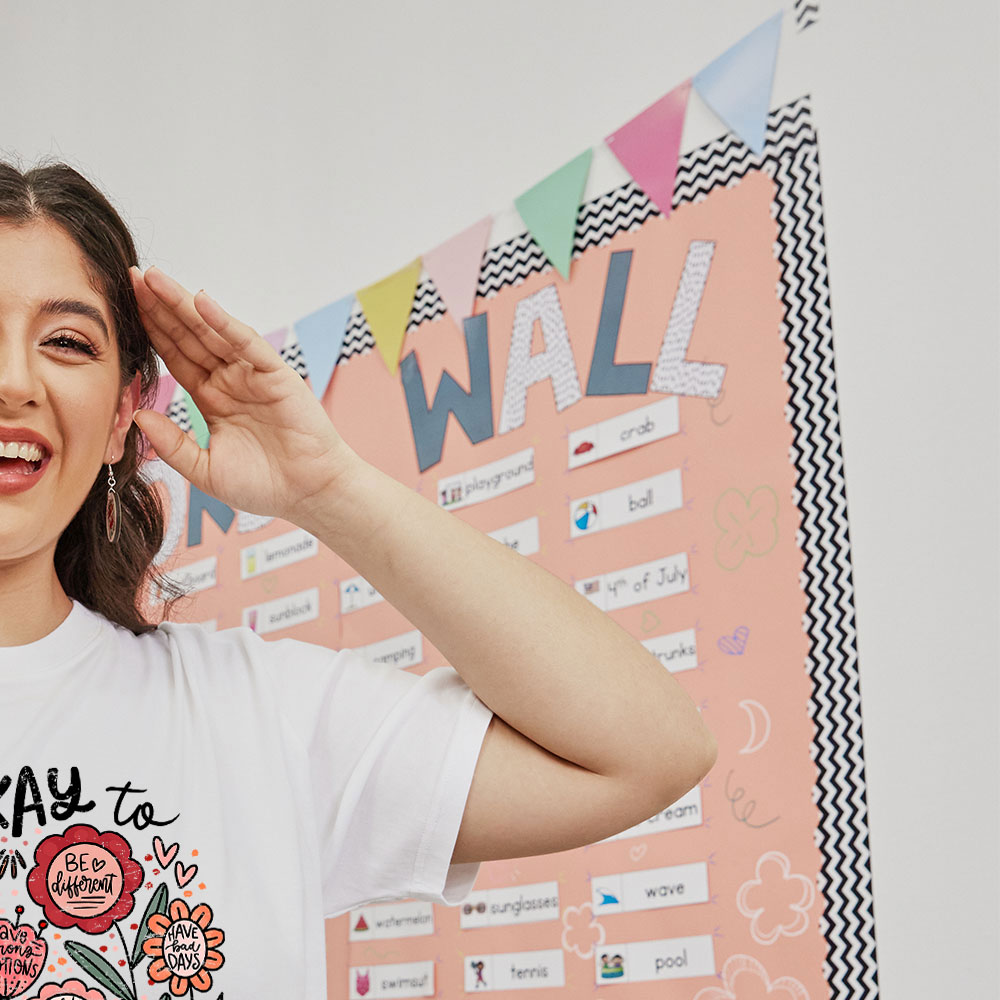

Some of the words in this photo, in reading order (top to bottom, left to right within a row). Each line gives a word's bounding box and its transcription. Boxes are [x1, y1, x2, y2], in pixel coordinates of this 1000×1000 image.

[400, 239, 728, 472] WALL
[619, 415, 655, 442] crab
[465, 453, 534, 496] playground
[627, 488, 654, 512] ball
[632, 571, 650, 592] of
[656, 564, 688, 586] July
[105, 781, 181, 831] to
[64, 852, 90, 872] BE
[51, 871, 118, 899] different
[645, 883, 685, 898] wave
[490, 894, 559, 917] sunglasses
[376, 911, 433, 928] watermelon
[168, 923, 199, 940] HAVE
[165, 940, 200, 953] bad
[167, 952, 200, 972] DAYS
[510, 964, 549, 980] tennis
[655, 947, 688, 974] pool
[381, 974, 428, 991] swimsuit
